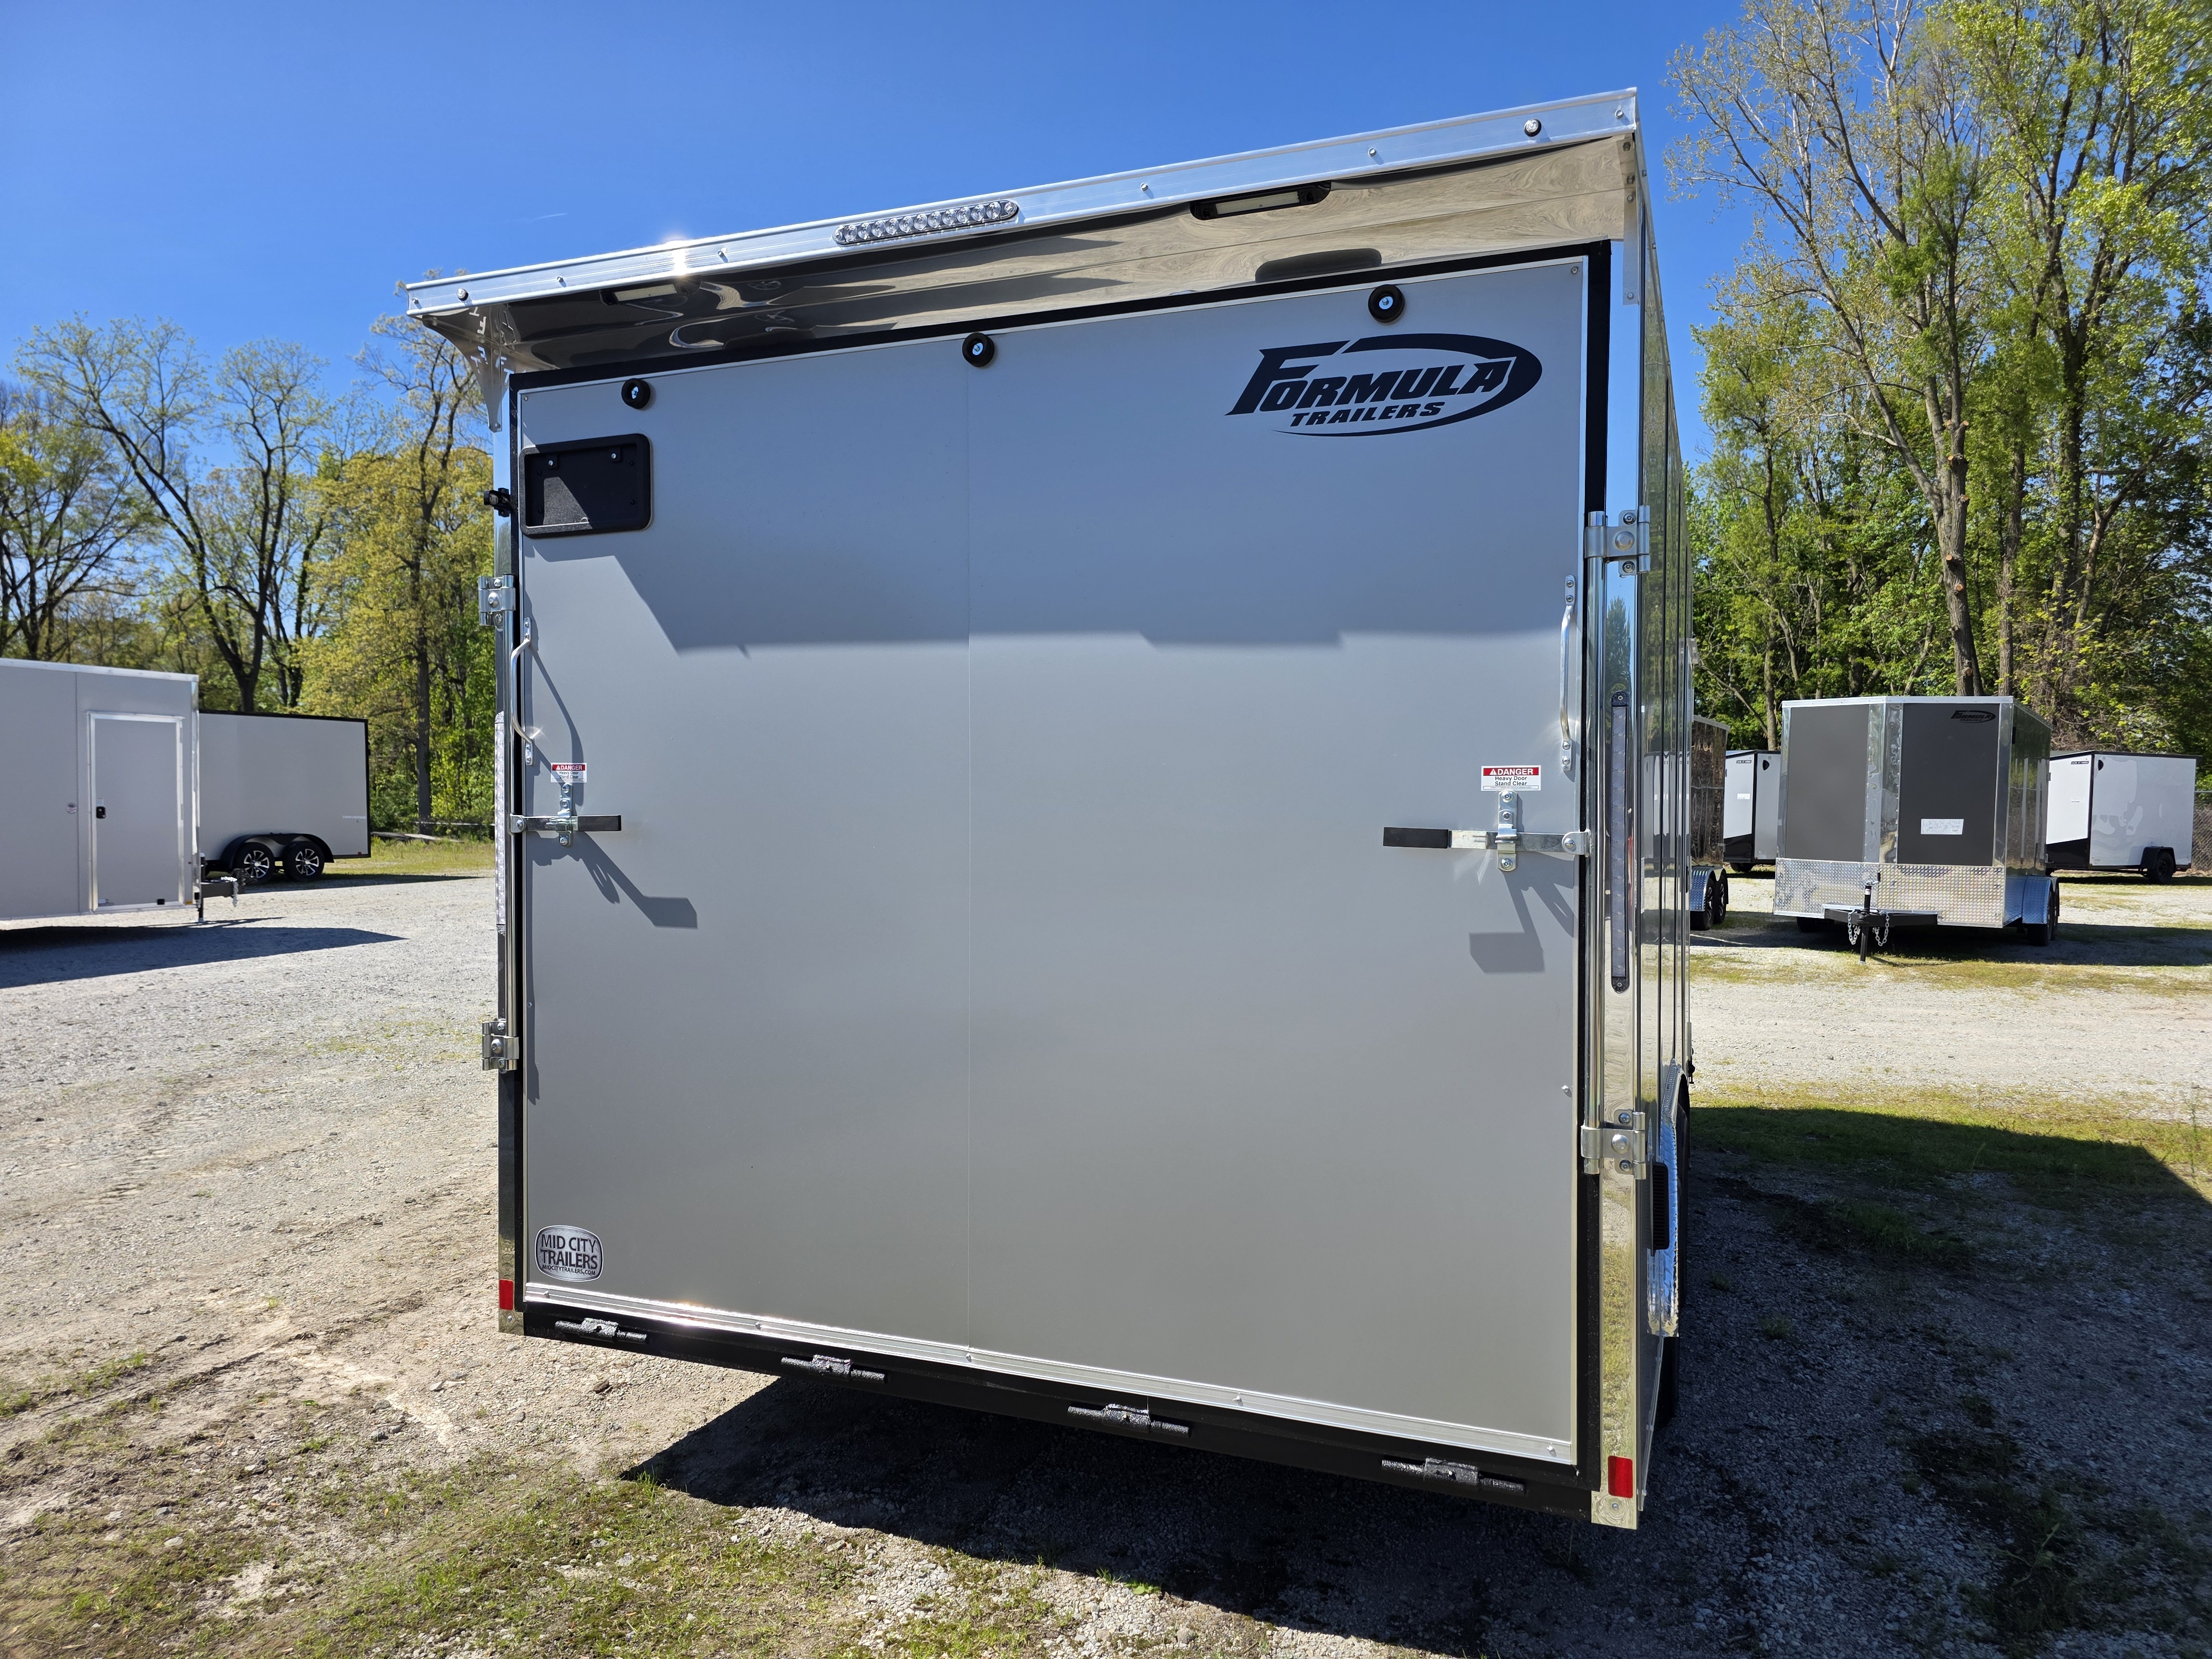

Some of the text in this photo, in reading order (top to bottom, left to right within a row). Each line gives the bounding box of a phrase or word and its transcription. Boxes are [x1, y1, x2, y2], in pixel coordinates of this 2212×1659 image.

[1224, 340, 1513, 416] FORMULA
[1290, 401, 1446, 427] TRAILERS
[541, 1234, 596, 1253] MID CITY
[540, 1248, 598, 1270] TRAILERS
[542, 1264, 596, 1276] MIDCITYTRAILERS.COM
